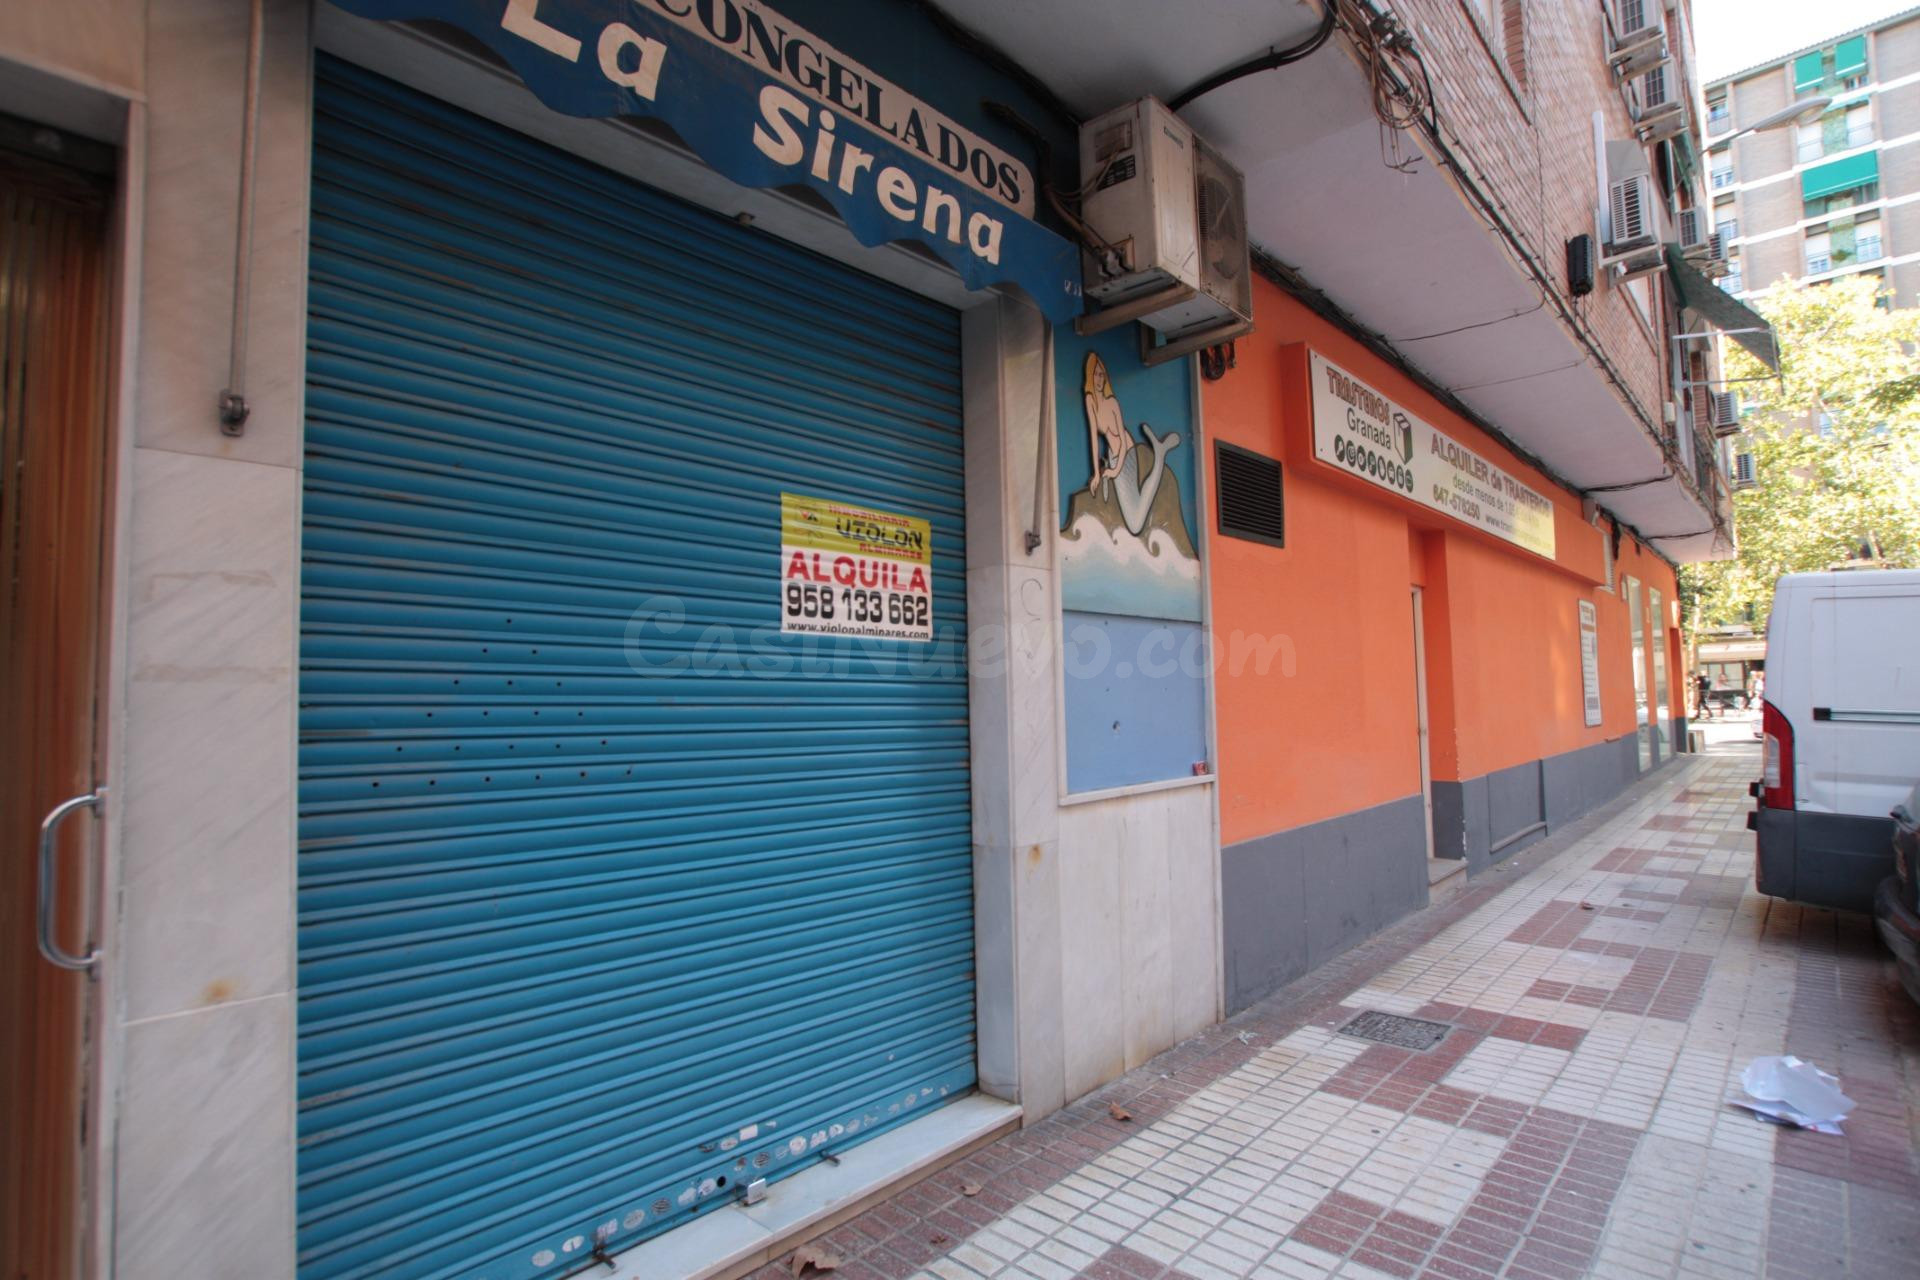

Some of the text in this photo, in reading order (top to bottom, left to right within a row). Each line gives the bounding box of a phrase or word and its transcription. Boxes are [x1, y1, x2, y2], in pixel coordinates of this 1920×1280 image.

[655, 0, 1021, 204] ONGELADOS
[753, 85, 1004, 266] Sirena
[1347, 407, 1391, 450] Granada
[1431, 433, 1489, 485] ALQUILER
[787, 551, 928, 593] ALQUILA
[787, 583, 928, 627] 958 133 662
[787, 622, 929, 639] www.violonalminares.com
